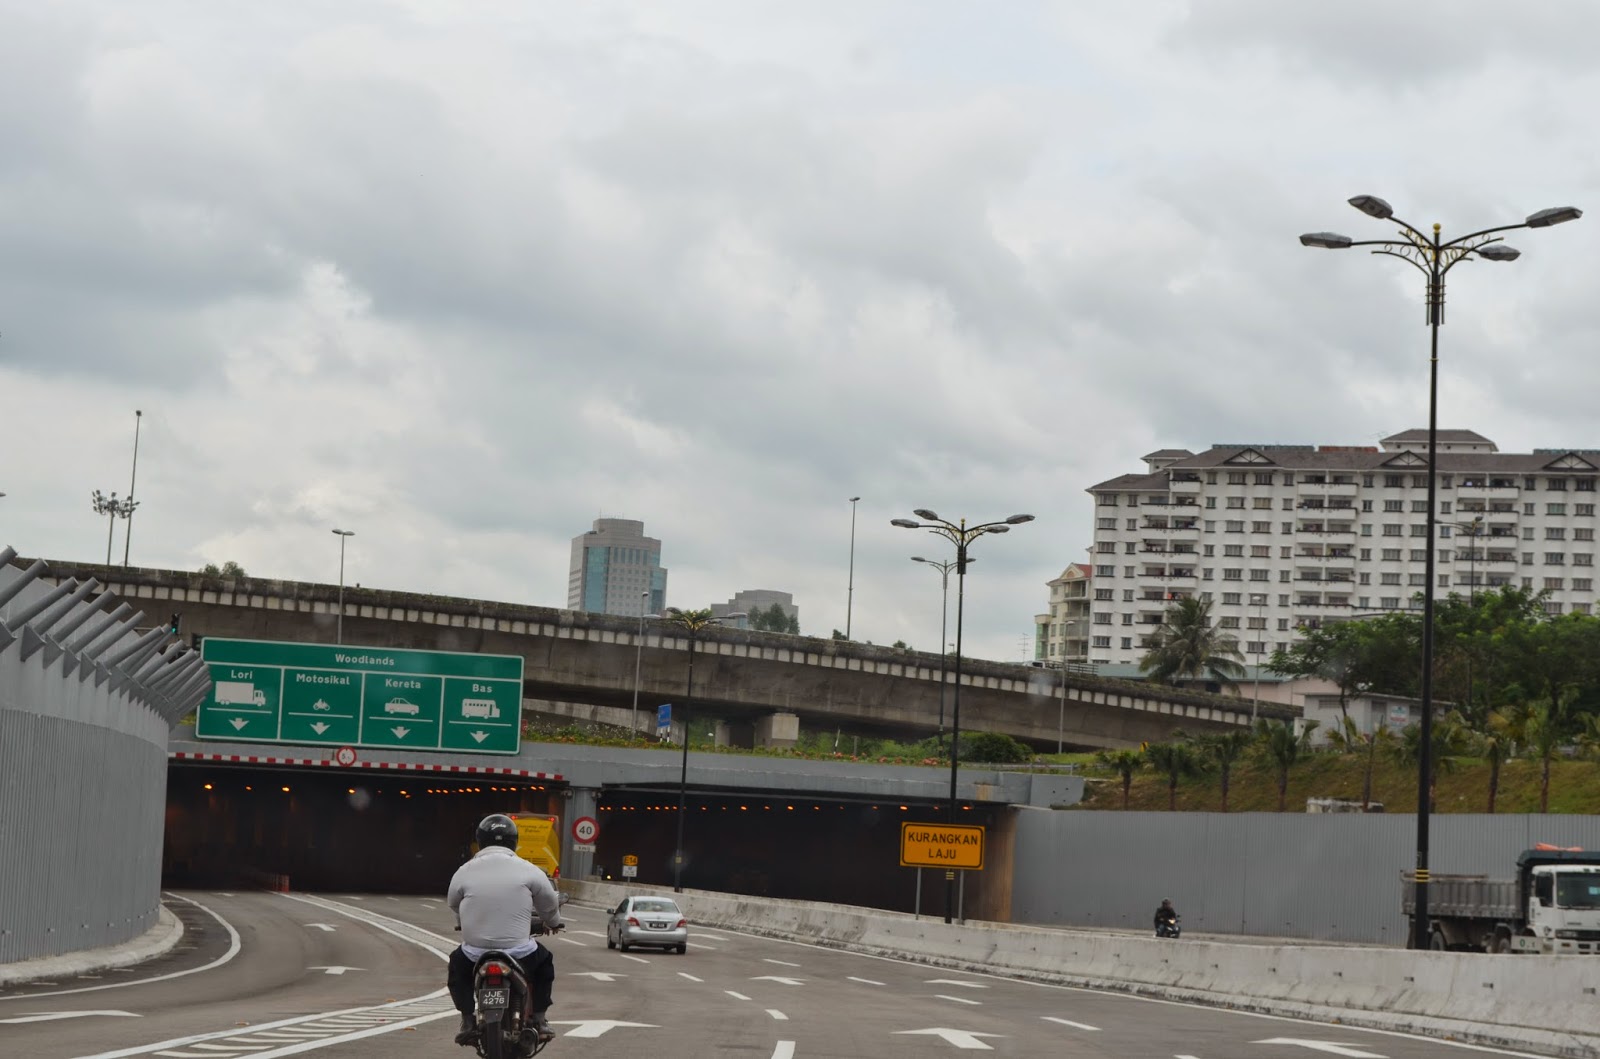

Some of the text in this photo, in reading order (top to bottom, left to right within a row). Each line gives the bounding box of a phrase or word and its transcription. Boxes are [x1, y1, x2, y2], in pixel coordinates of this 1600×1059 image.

[335, 653, 394, 666] Woodlands
[230, 670, 253, 680] Lori
[296, 674, 350, 685] Motosikal
[385, 678, 422, 689] Kereta
[472, 684, 493, 693] Bas
[579, 826, 592, 834] 40
[908, 832, 978, 846] KURANGKAN
[928, 848, 956, 859] LAJU
[624, 856, 636, 864] E14
